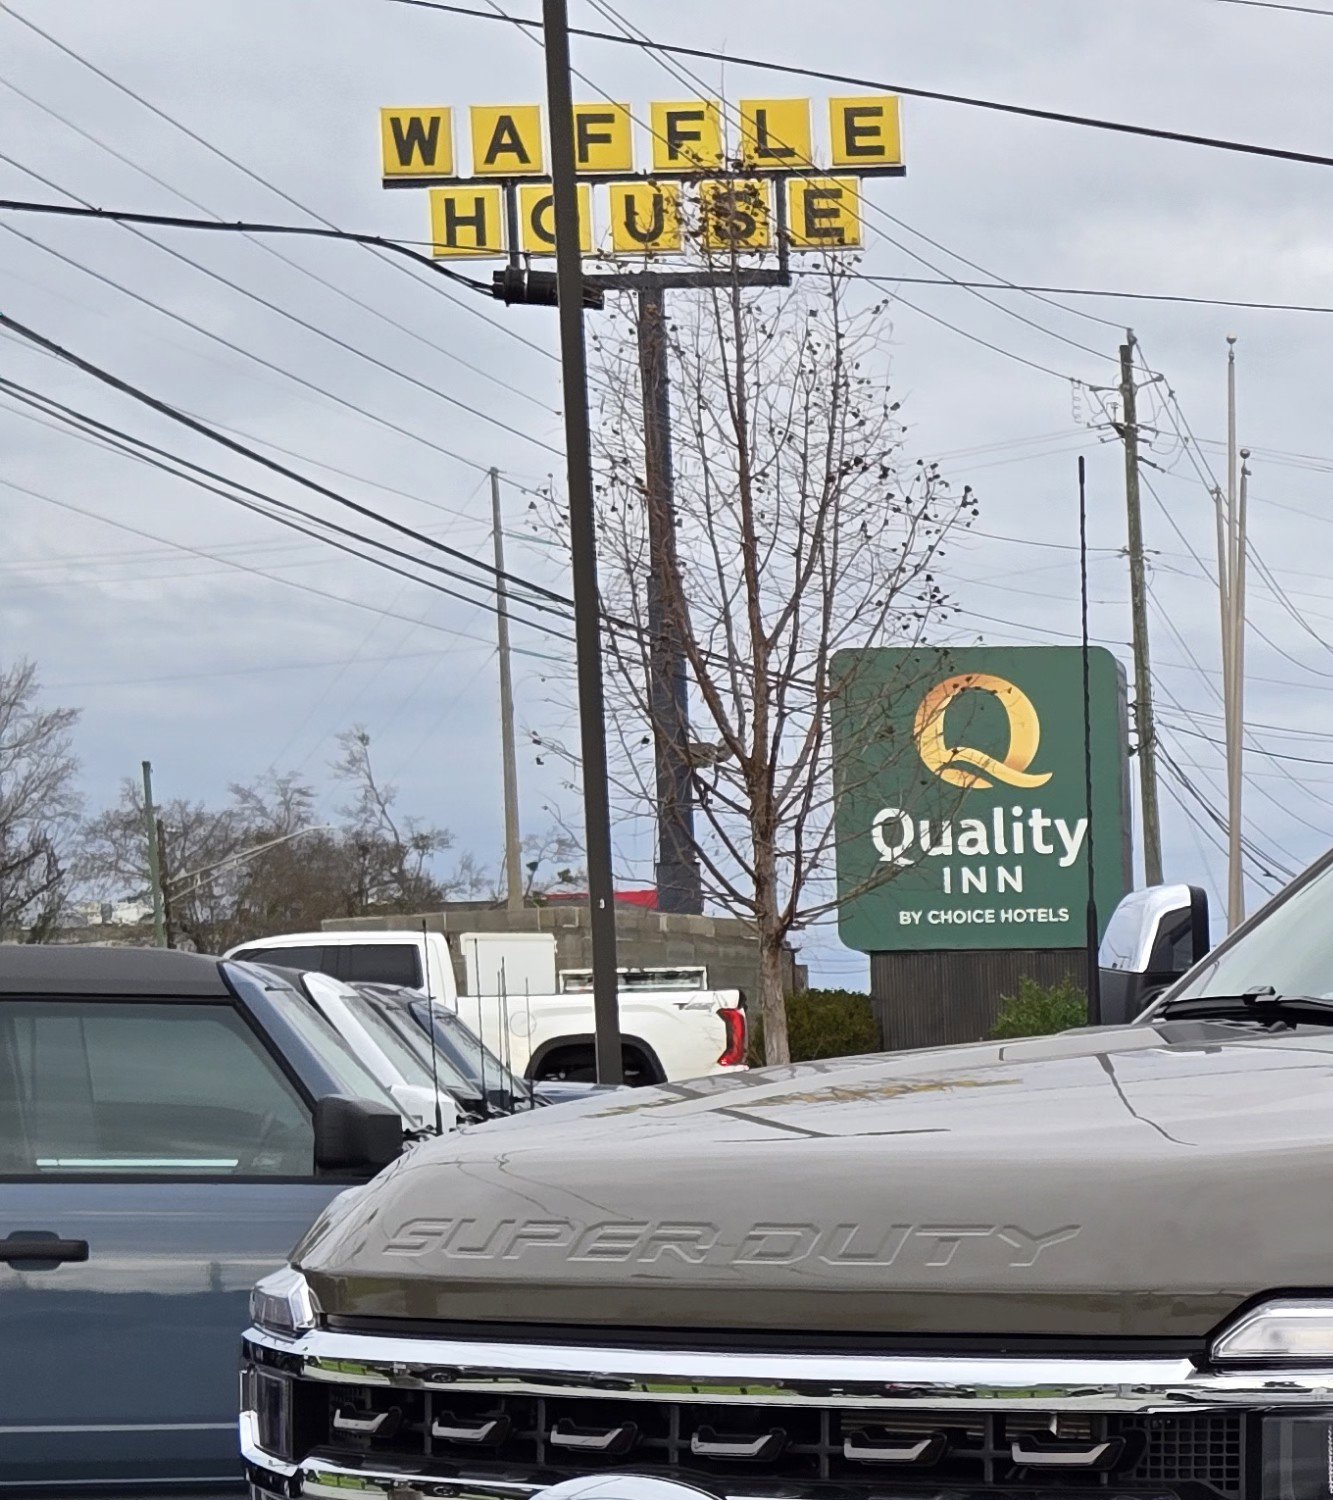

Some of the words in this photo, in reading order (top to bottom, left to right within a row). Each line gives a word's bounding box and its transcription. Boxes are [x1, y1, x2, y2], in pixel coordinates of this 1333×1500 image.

[390, 106, 886, 167] WAFFLE
[871, 806, 1089, 867] Quality
[943, 866, 1023, 894] INN
[899, 910, 922, 925] BY
[927, 909, 995, 924] CHOICE
[1000, 908, 1070, 923] HOTELS
[383, 1217, 726, 1263] SUPER
[735, 1222, 1082, 1267] DUTY
